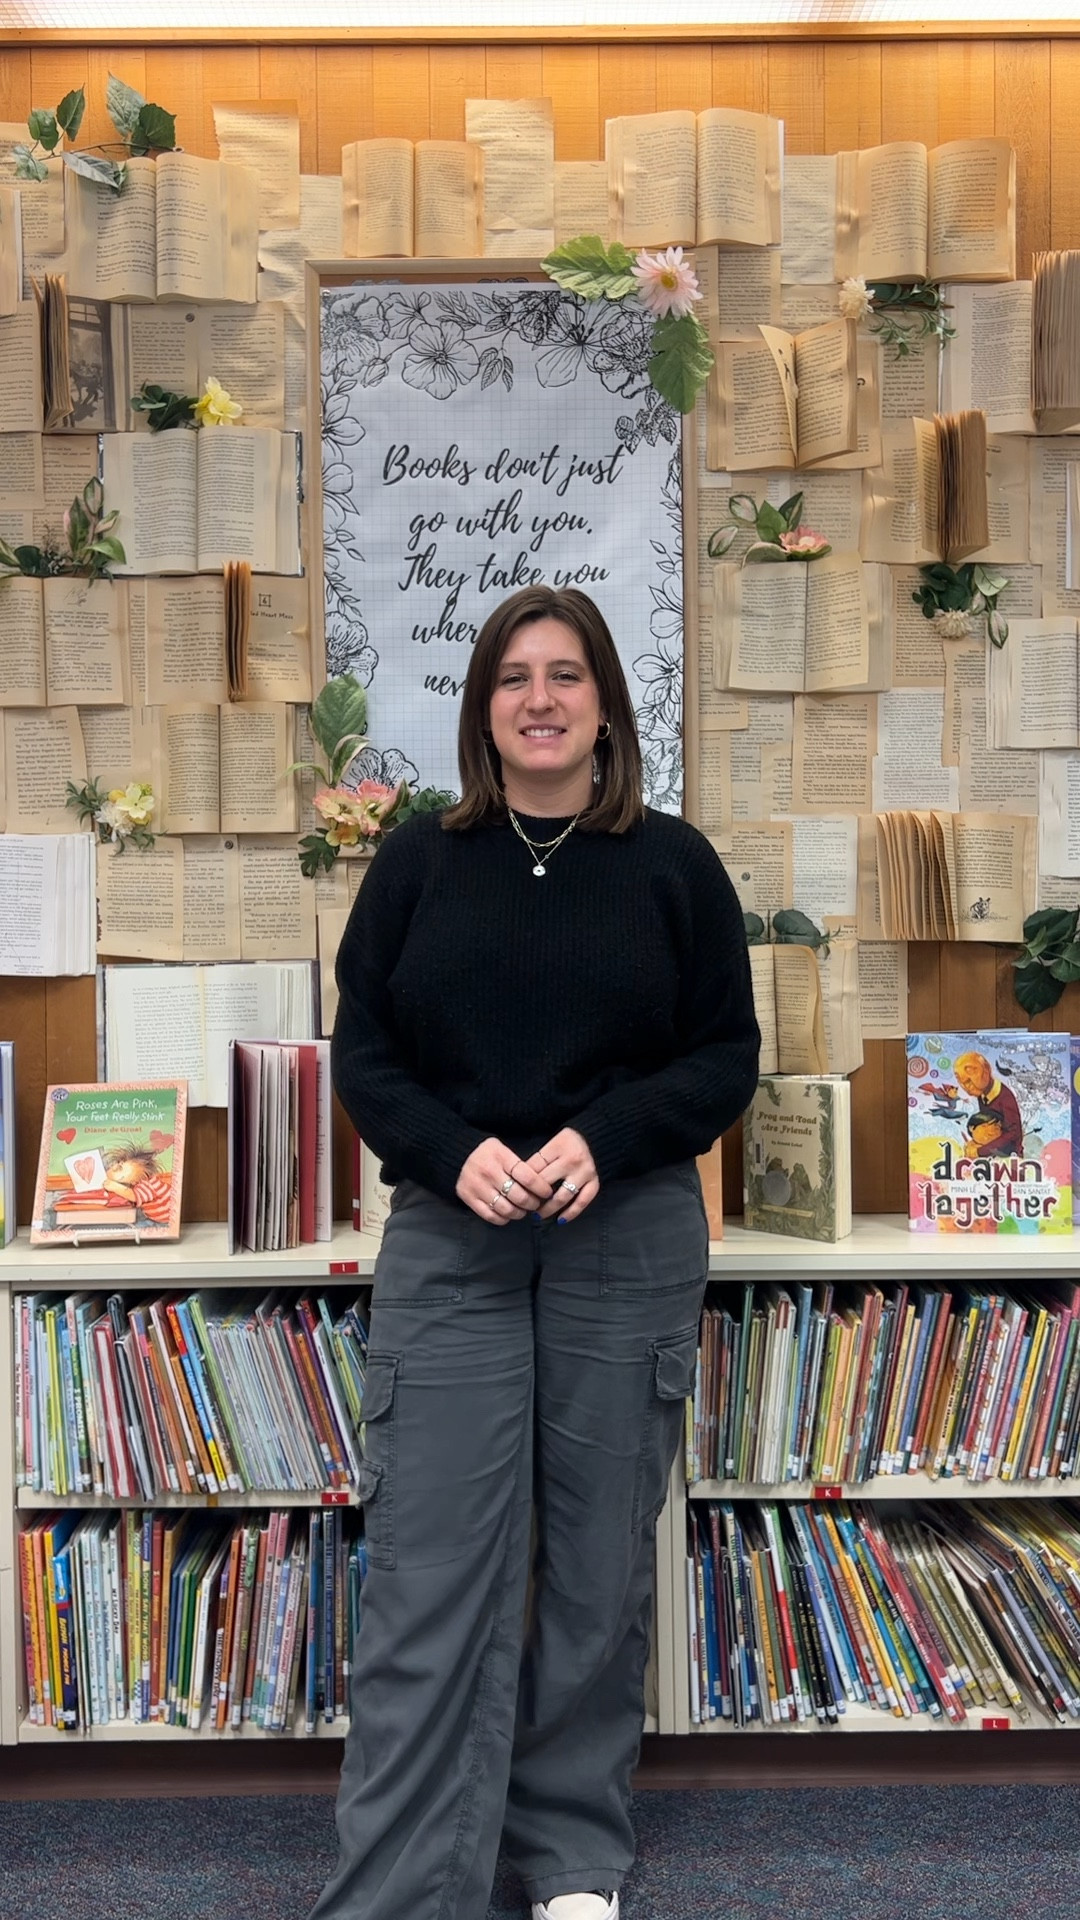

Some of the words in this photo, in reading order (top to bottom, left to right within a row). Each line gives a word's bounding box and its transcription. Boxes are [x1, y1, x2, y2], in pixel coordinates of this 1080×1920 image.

[382, 444, 477, 485] Books
[485, 444, 560, 485] don't
[555, 444, 625, 497] just
[407, 511, 447, 550] go
[456, 489, 523, 539] with
[530, 511, 593, 551] you.
[398, 543, 472, 605] They
[476, 552, 545, 593] take
[552, 563, 610, 588] you
[411, 603, 478, 644] wher
[65, 1110, 88, 1122] Your
[91, 1111, 109, 1121] Feet
[112, 1111, 139, 1124] Really
[140, 1112, 165, 1121] Stink
[76, 1101, 108, 1111] Roses
[110, 1099, 129, 1109] Are
[132, 1098, 158, 1109] Pink,
[756, 1111, 777, 1122] Frog
[779, 1114, 794, 1122] and
[795, 1115, 817, 1124] Toad
[761, 1123, 778, 1132] Are
[780, 1125, 812, 1136] Friends
[933, 1142, 1043, 1182] drawn
[918, 1182, 1057, 1227] together
[980, 1340, 993, 1375] ROBERTO
[75, 1396, 86, 1441] PROMISE
[331, 1494, 337, 1502] K
[825, 1489, 831, 1497] K
[730, 1534, 738, 1562] LUNCH
[735, 1577, 743, 1601] HOME
[59, 1617, 69, 1644] BATMAN
[142, 1615, 150, 1634] THAT
[992, 1720, 998, 1728] L
